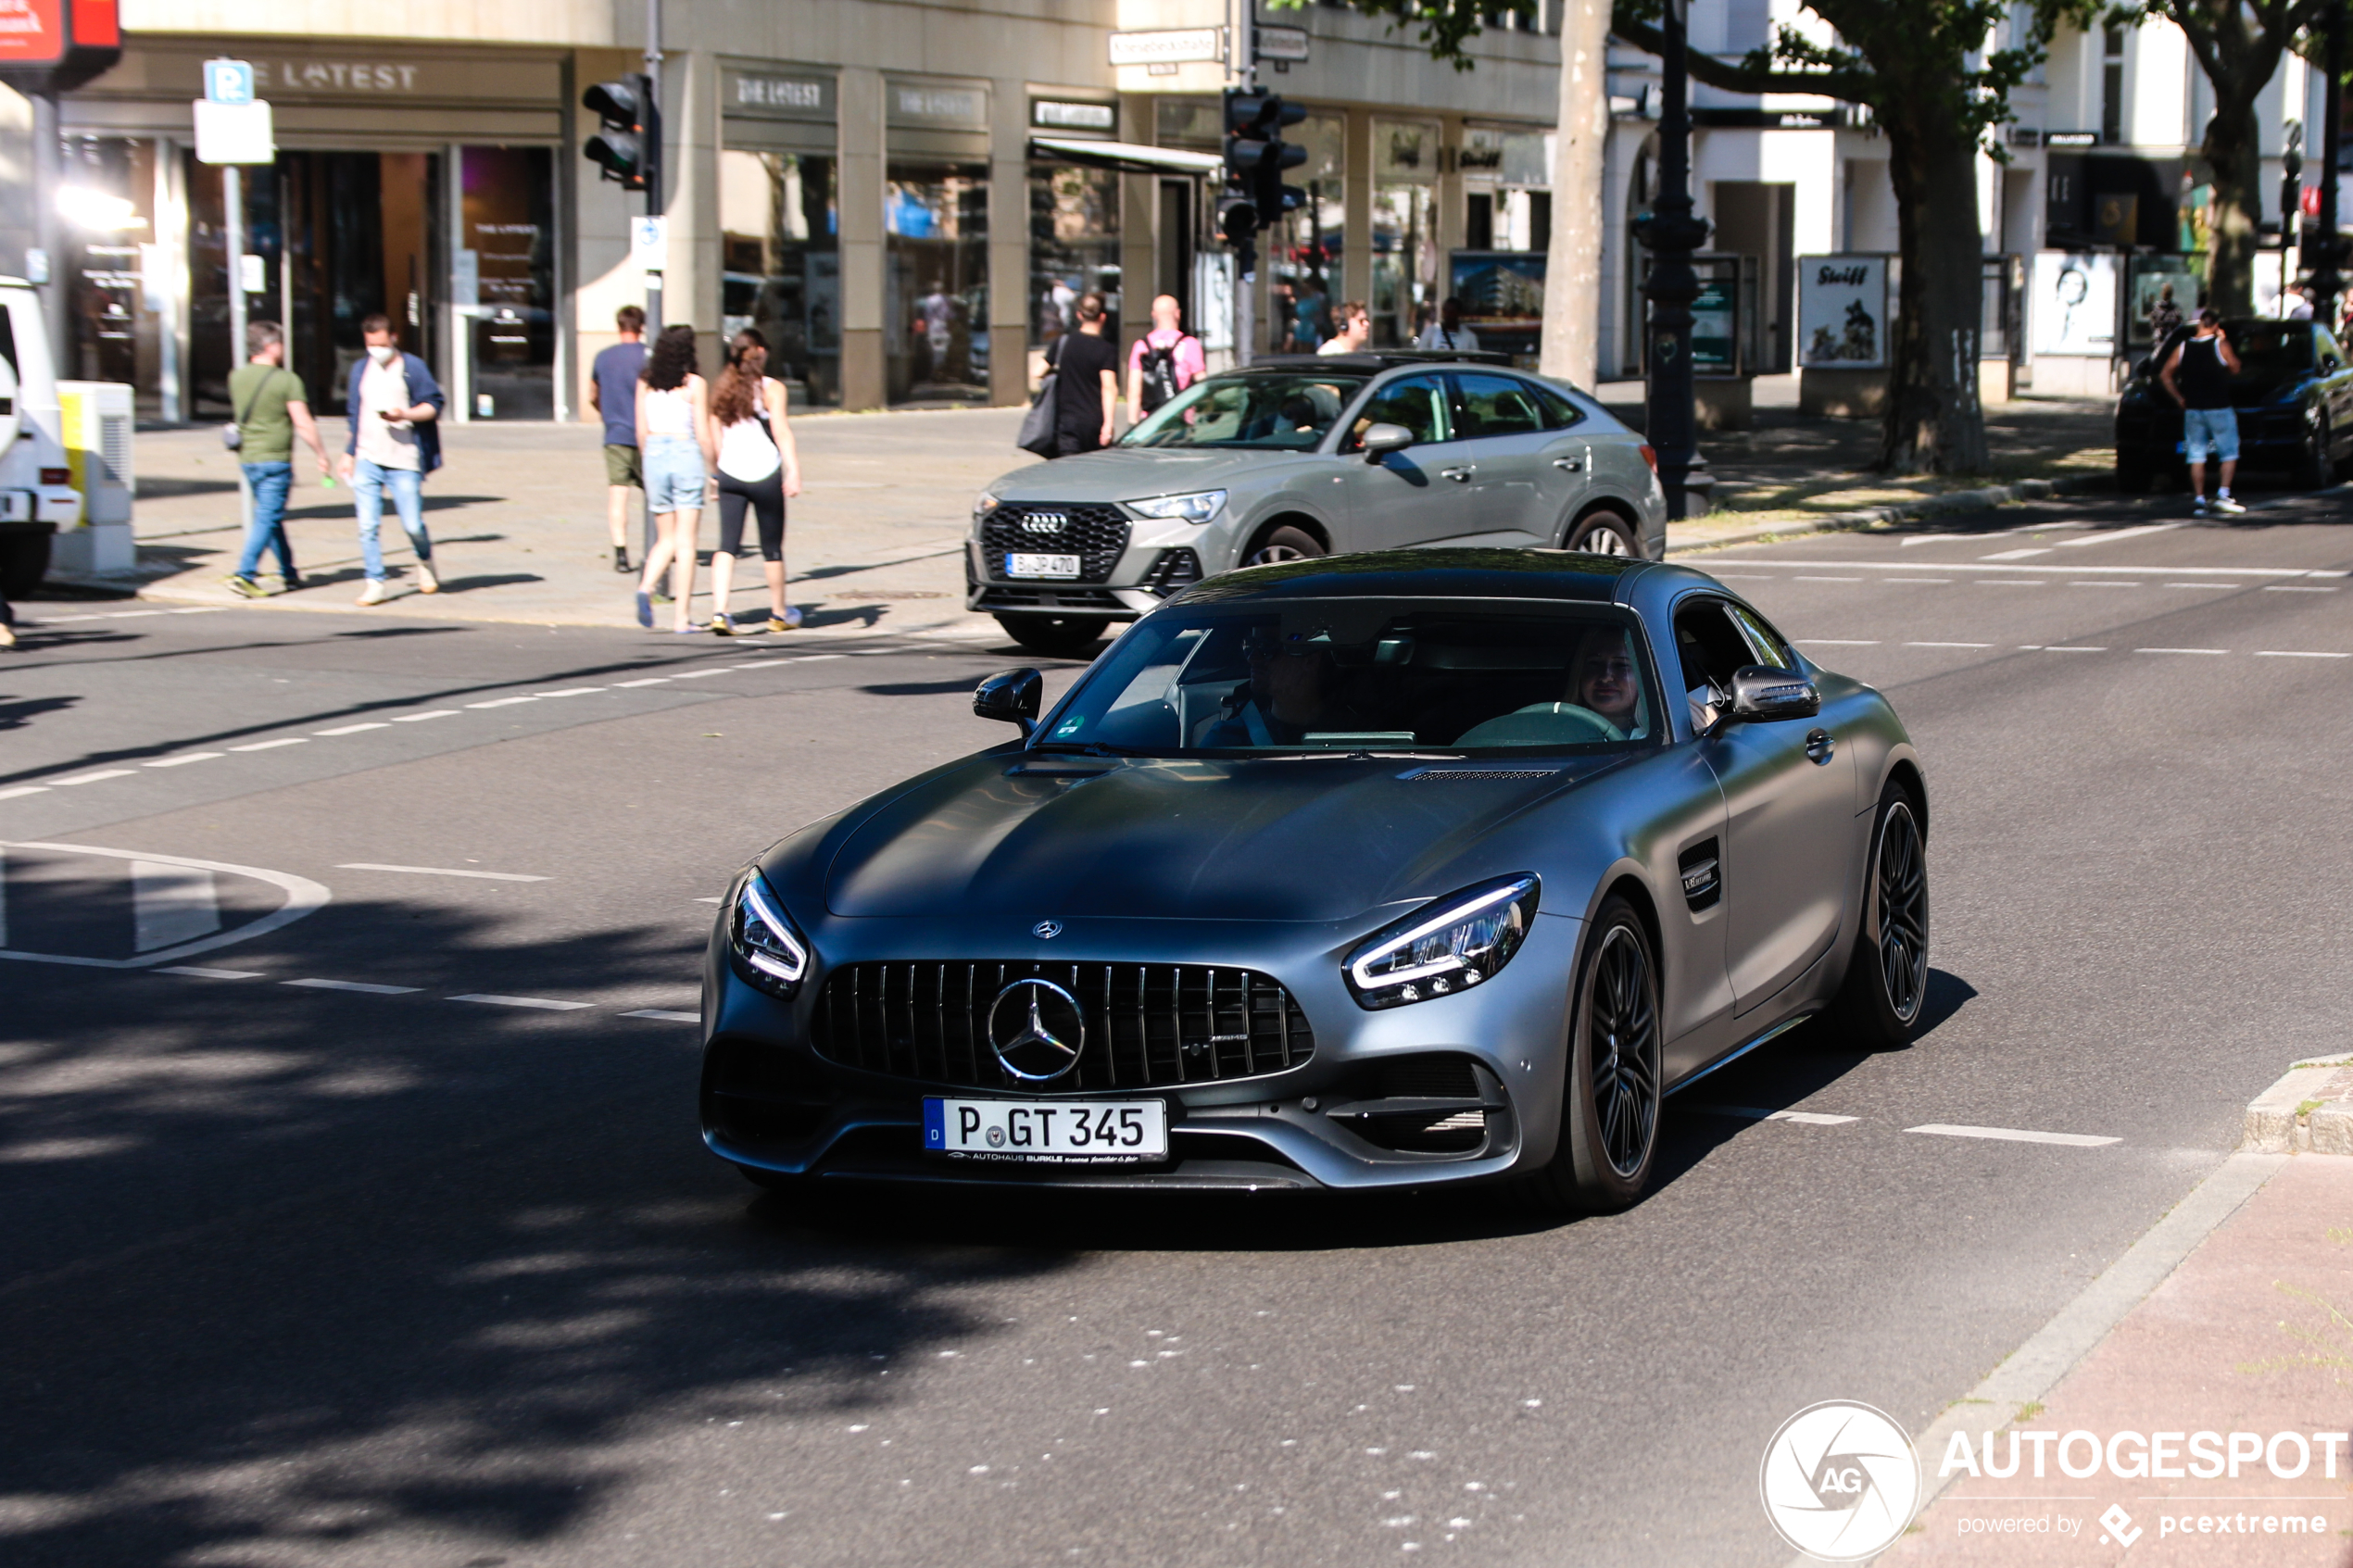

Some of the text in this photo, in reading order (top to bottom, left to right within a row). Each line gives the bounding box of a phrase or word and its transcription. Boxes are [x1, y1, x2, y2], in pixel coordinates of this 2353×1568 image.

[283, 62, 417, 91] LATEST
[1818, 264, 1869, 285] Steiff
[1685, 877, 1695, 889] V8
[958, 1106, 1143, 1147] P GT 345
[931, 1129, 938, 1141] D
[973, 1152, 1025, 1161] AUTOHAUS
